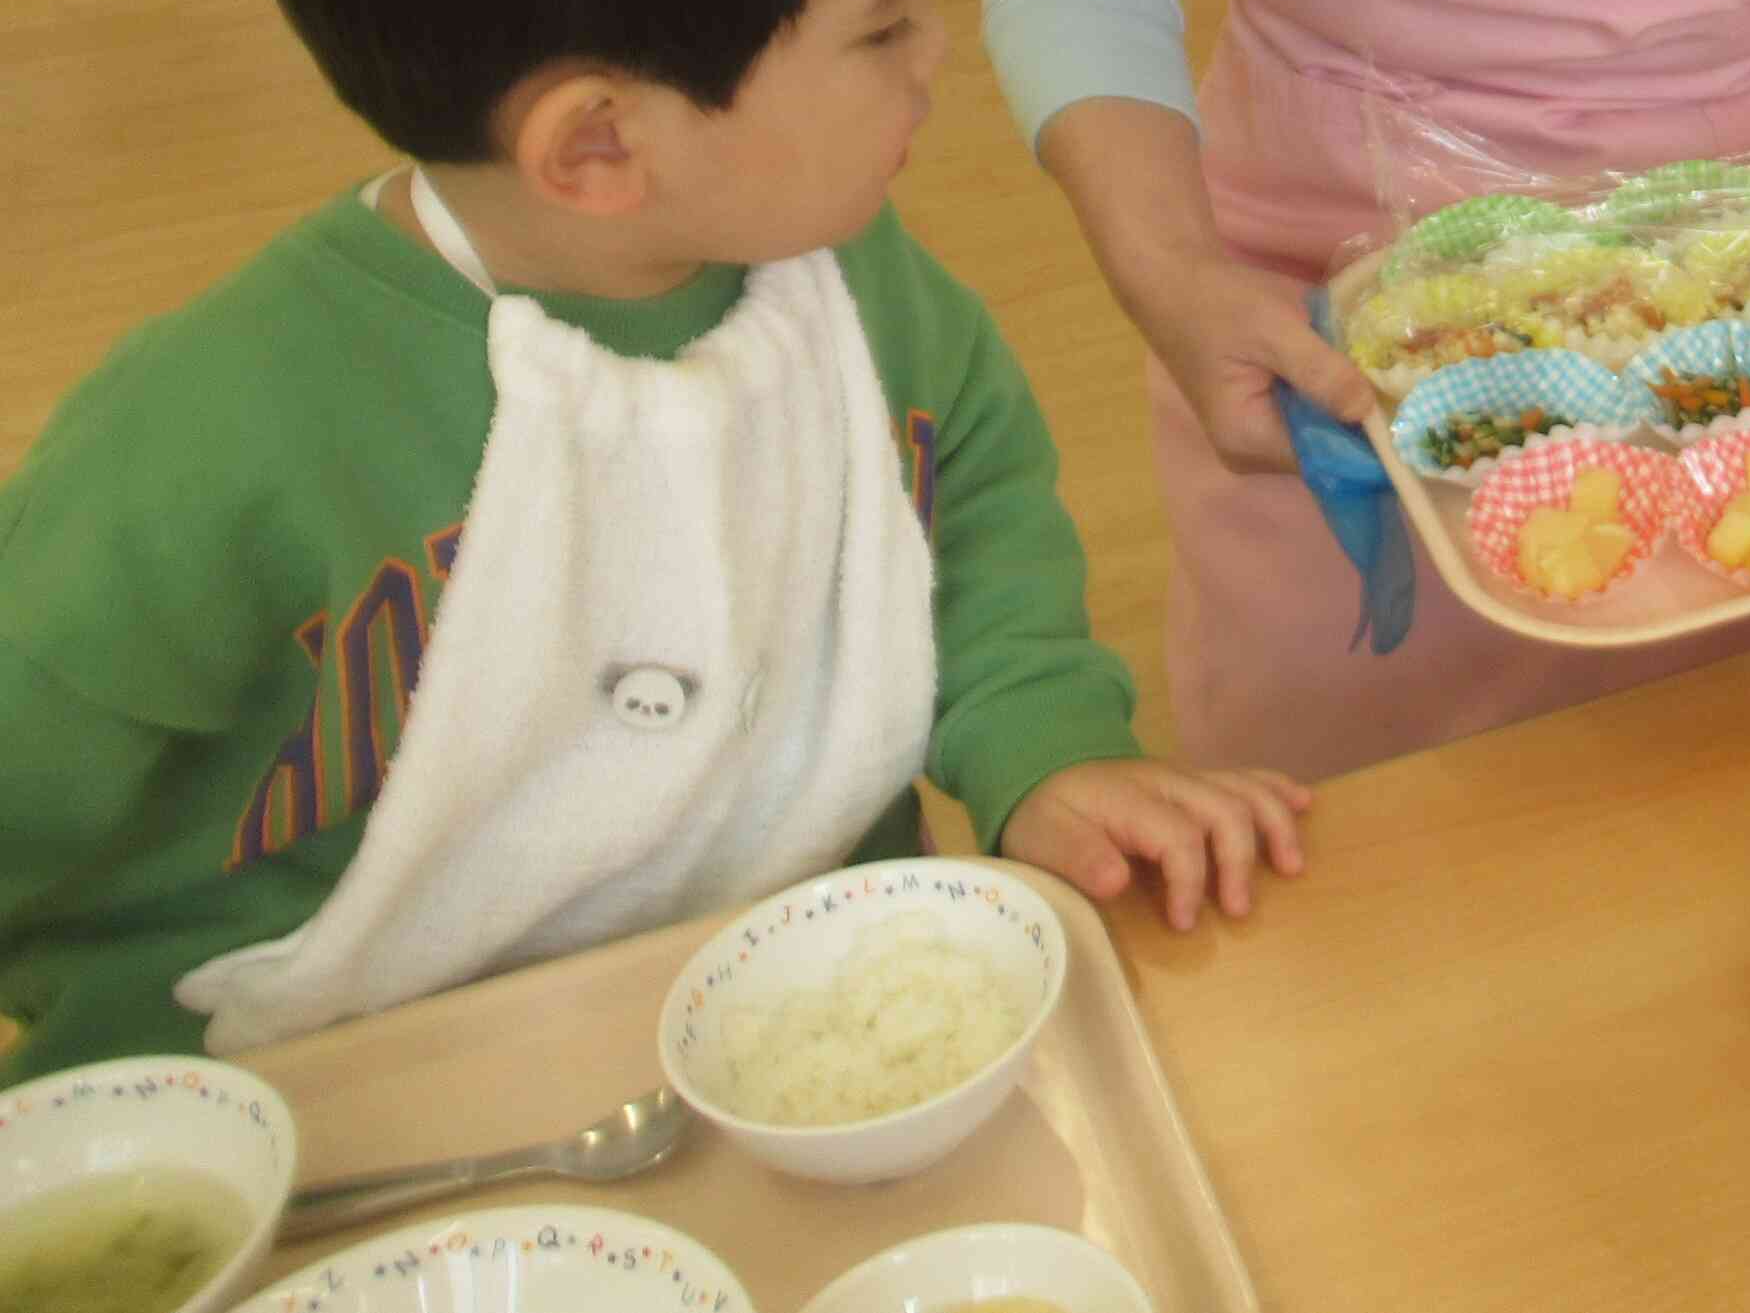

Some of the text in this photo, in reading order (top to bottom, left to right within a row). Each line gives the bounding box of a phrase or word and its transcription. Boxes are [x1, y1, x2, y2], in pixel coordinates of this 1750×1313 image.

[822, 894, 838, 913] K
[902, 873, 921, 892] M
[947, 880, 968, 905] N
[250, 1100, 262, 1123] Q
[537, 1224, 561, 1248] Q
[623, 1247, 638, 1271] S
